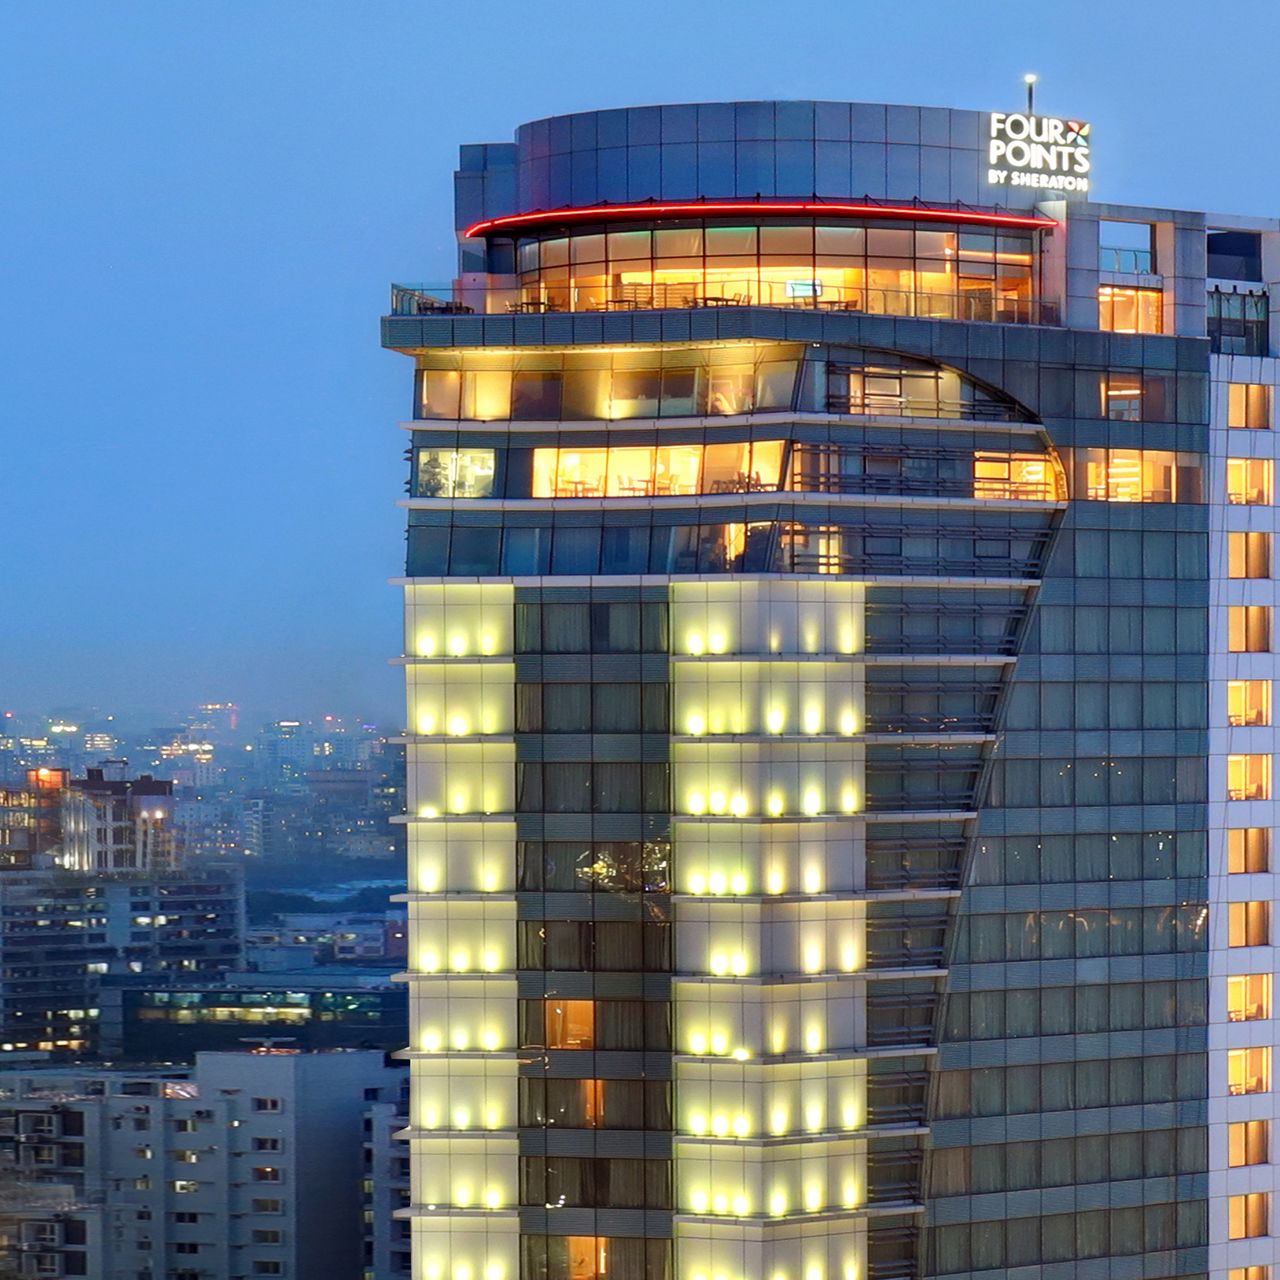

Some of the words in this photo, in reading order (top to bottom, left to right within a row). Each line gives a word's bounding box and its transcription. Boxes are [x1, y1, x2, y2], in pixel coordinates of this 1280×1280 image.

[990, 112, 1066, 145] FOUR
[989, 139, 1090, 173] POINTS
[988, 169, 1008, 184] BY
[1011, 171, 1089, 192] SHERATON
